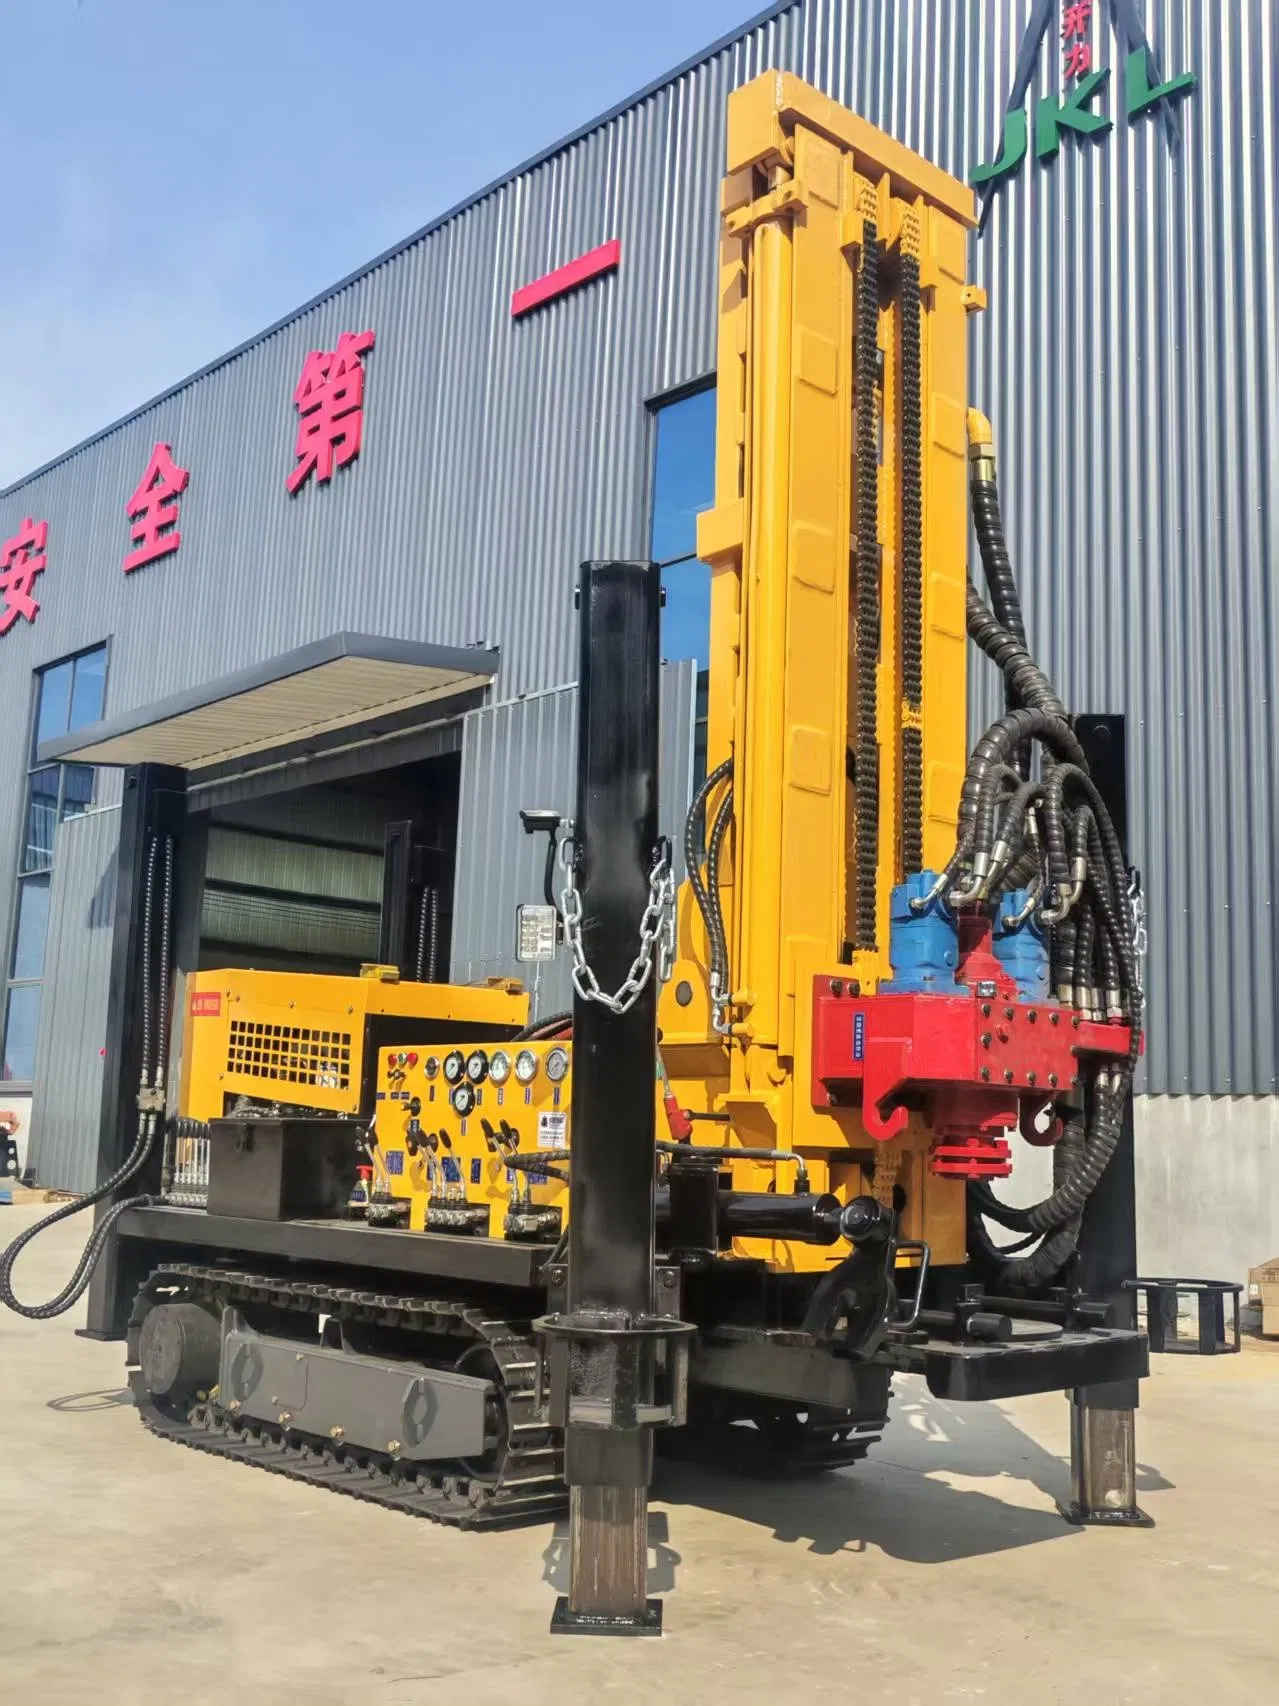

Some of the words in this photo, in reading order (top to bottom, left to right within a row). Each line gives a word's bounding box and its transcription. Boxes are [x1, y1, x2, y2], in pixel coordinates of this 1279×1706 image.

[969, 47, 1198, 183] JKL
[0, 239, 621, 636] 安全第一
